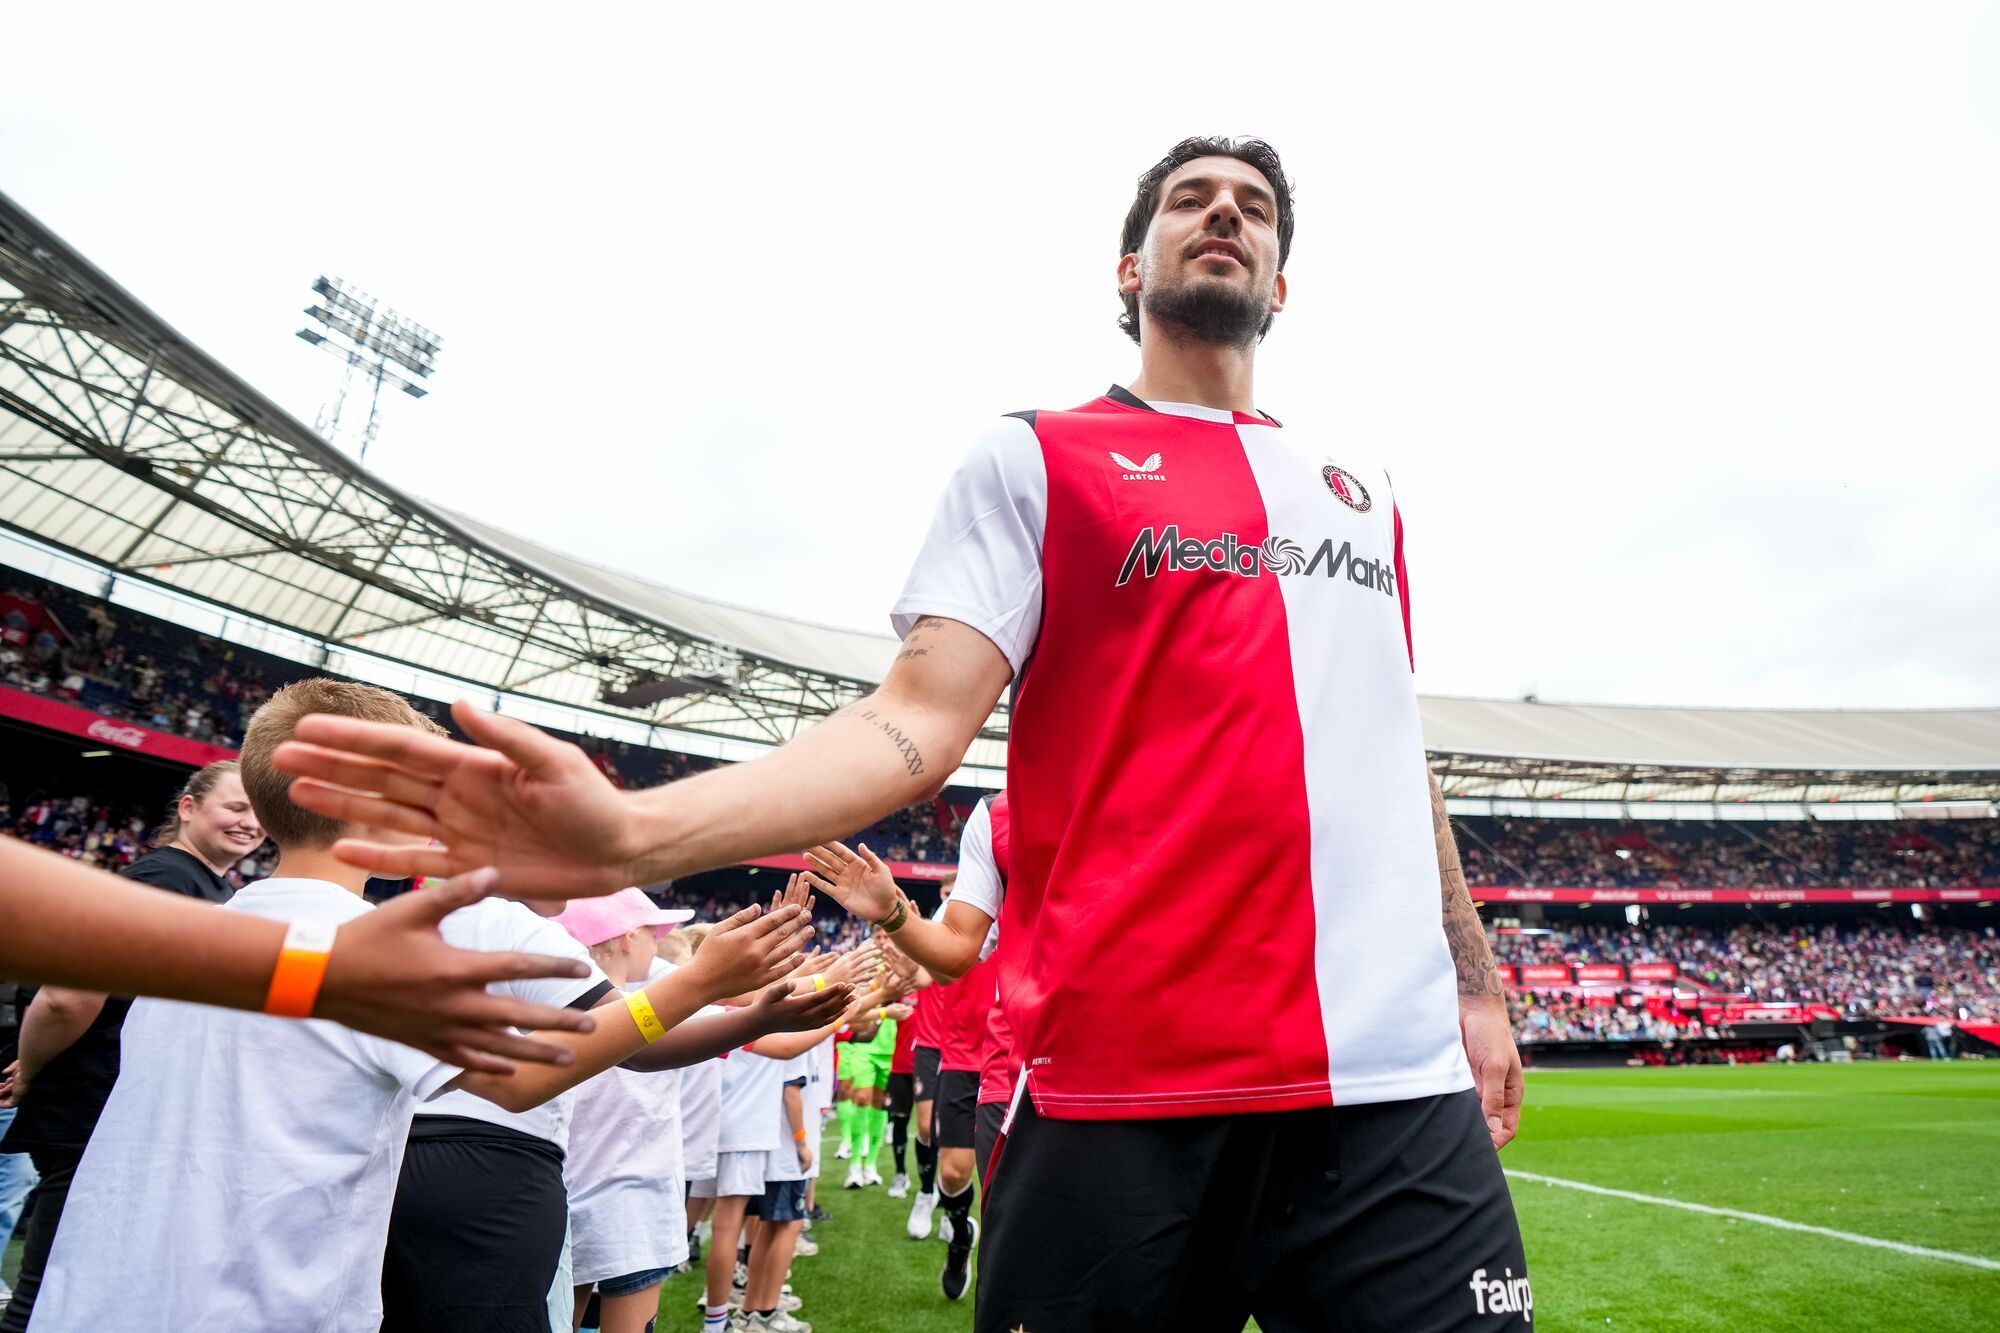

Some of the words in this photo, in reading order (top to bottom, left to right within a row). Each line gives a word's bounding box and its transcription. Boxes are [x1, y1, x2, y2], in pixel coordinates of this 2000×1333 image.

[1122, 474, 1166, 482] CASTORE
[1115, 525, 1260, 588] Media
[1303, 539, 1394, 597] Markt
